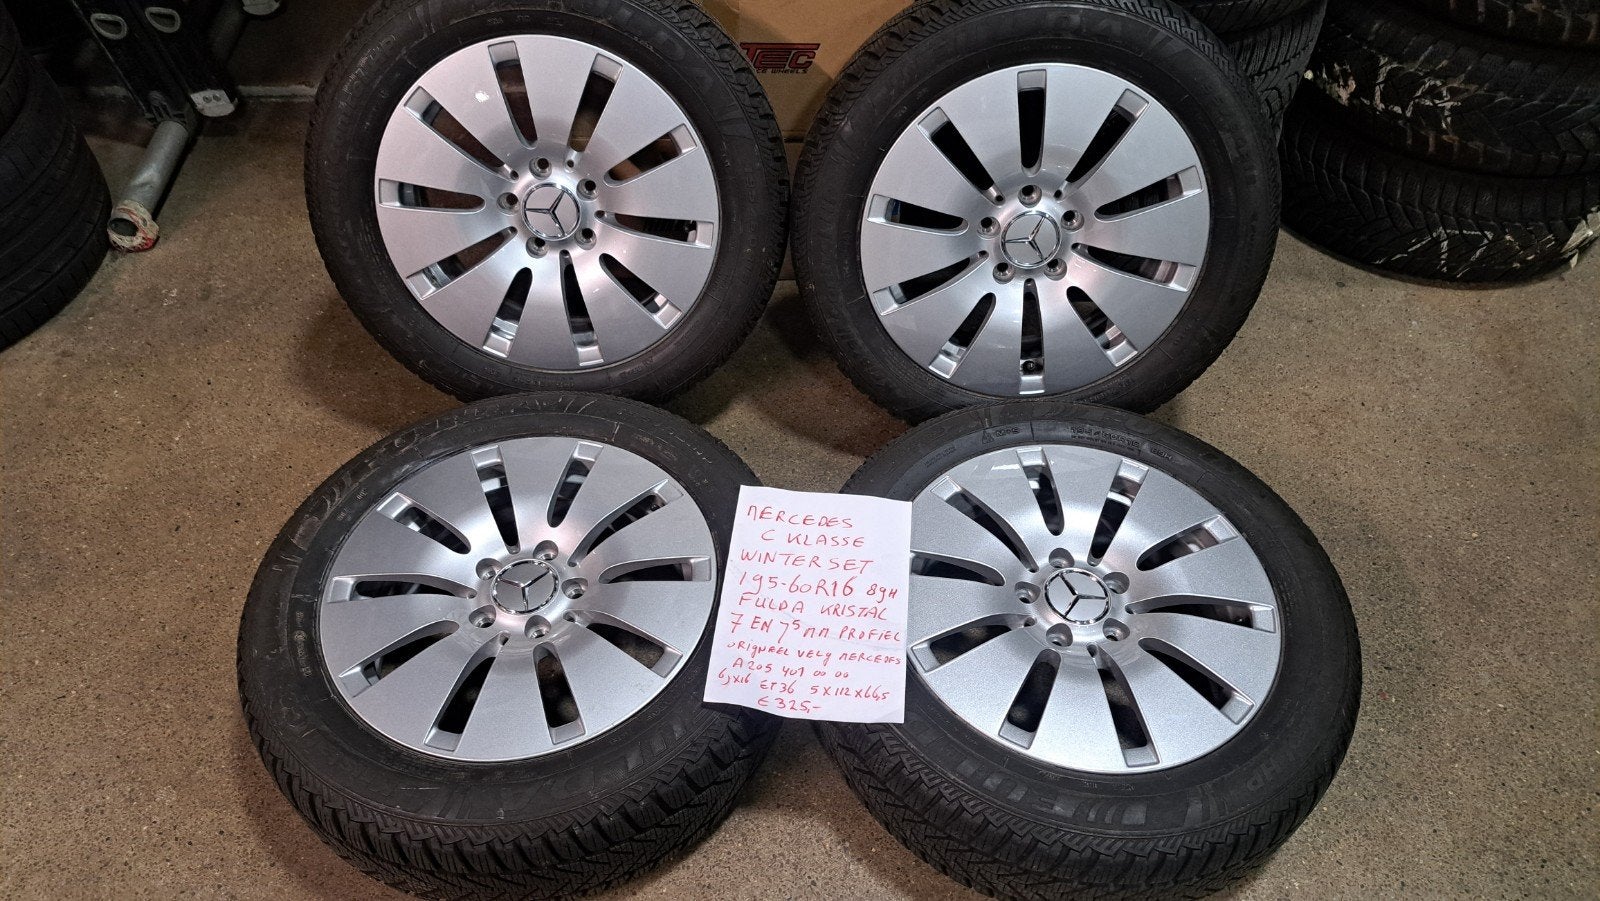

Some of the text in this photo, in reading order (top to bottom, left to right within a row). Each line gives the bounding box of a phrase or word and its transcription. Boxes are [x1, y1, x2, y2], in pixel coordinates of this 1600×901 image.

[747, 505, 854, 529] MERCEDES
[761, 529, 865, 548] C KLASSE
[739, 594, 887, 621] FULDA KRISTAL
[731, 612, 744, 634] 7
[750, 615, 774, 633] EN
